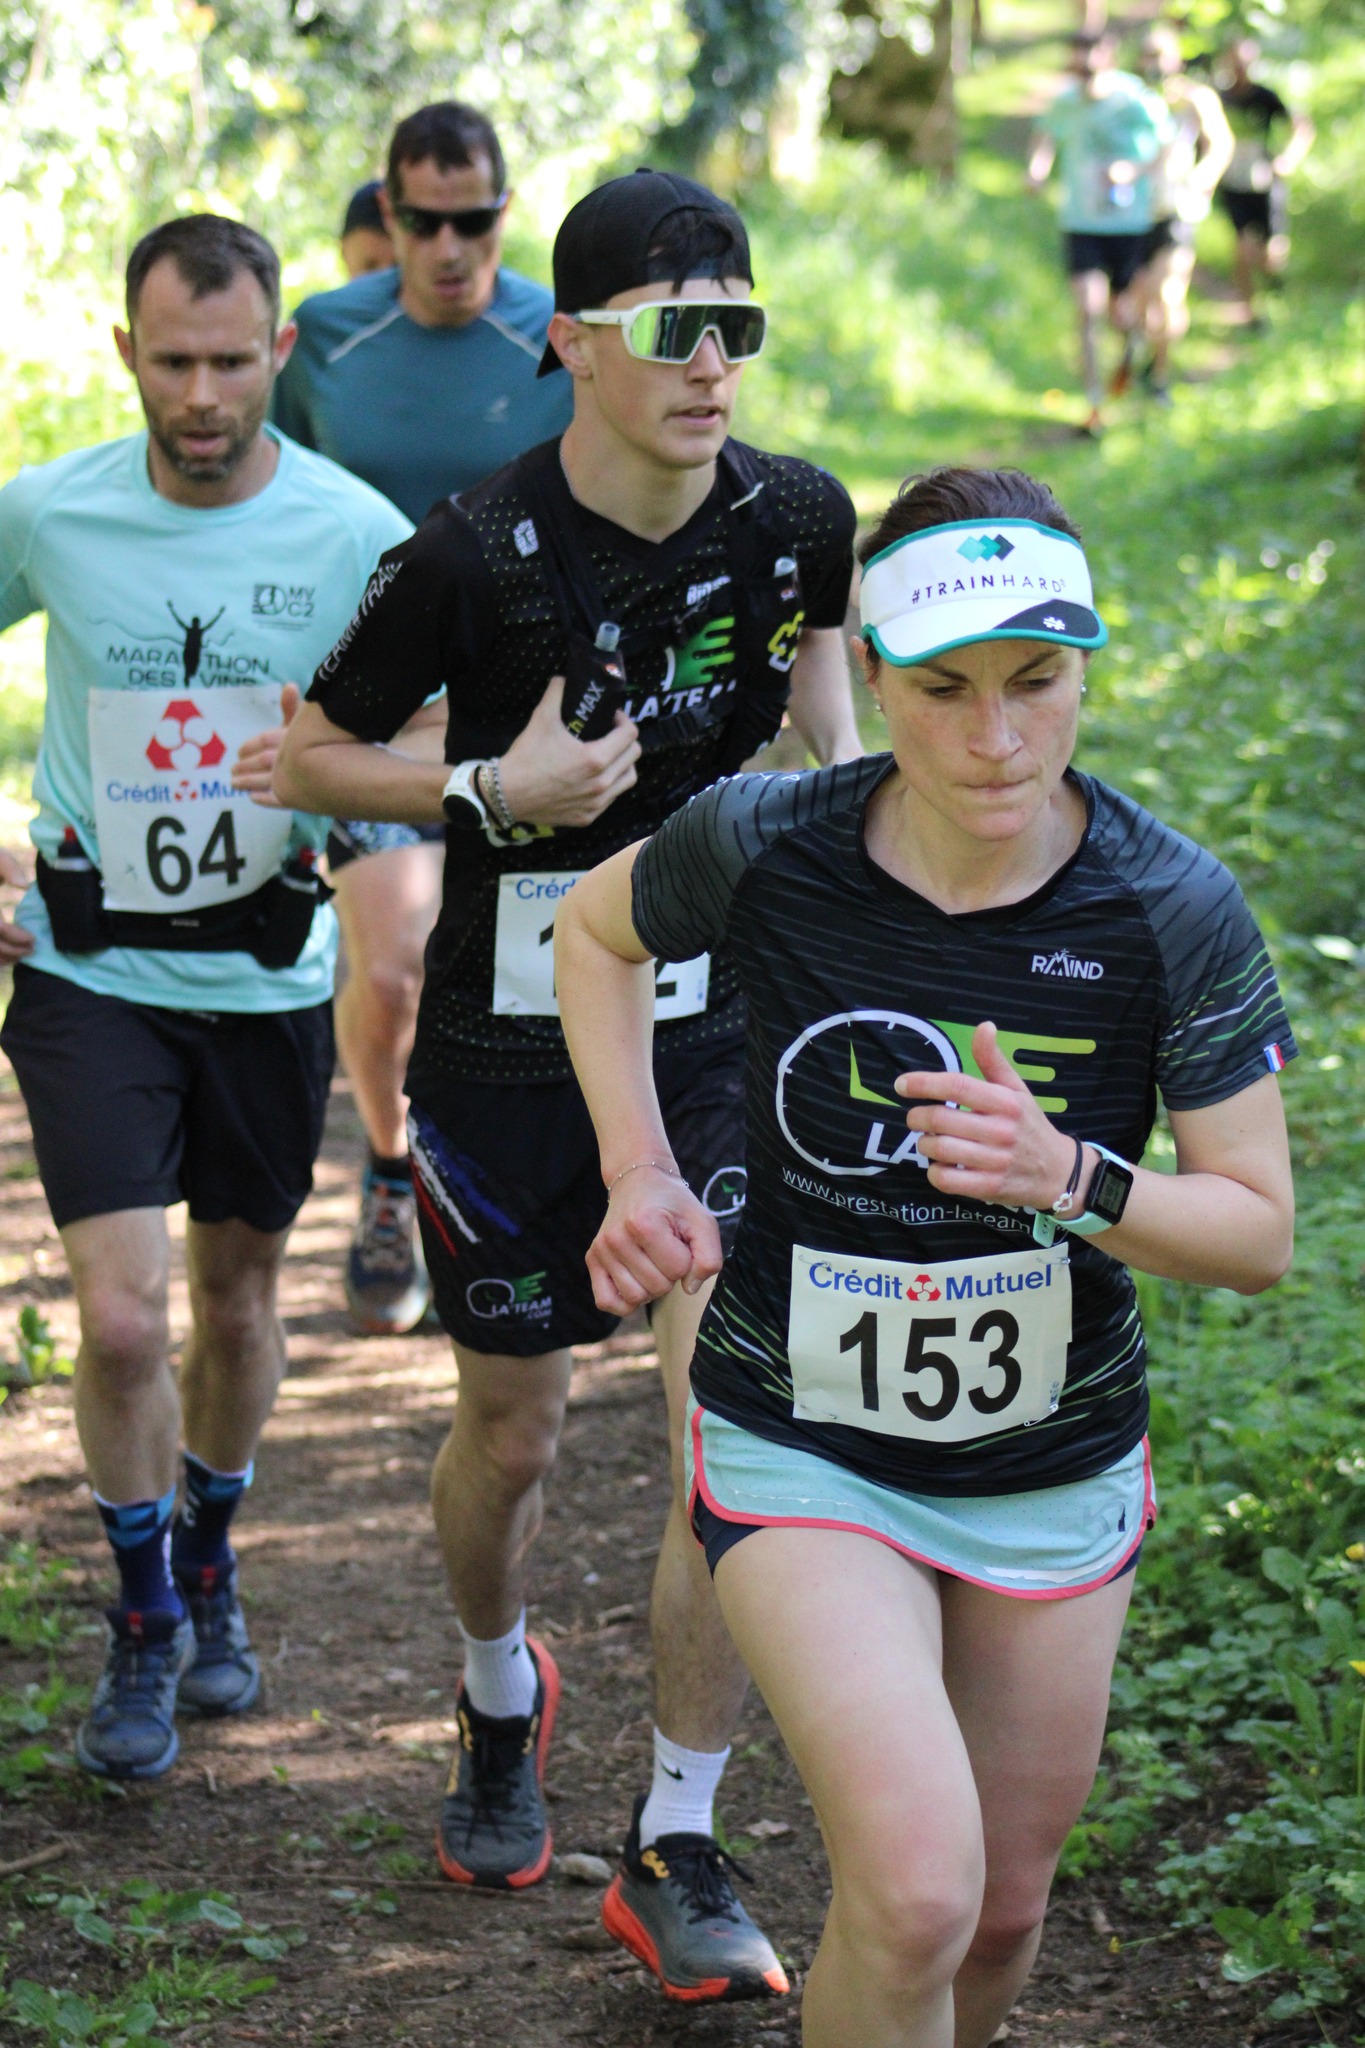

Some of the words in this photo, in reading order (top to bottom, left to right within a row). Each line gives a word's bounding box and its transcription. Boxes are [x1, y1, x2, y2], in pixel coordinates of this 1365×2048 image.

[288, 602, 314, 618] C2
[128, 669, 176, 687] DES
[575, 680, 605, 722] MAX
[107, 782, 171, 803] Crédit
[146, 810, 246, 896] 64
[808, 1262, 903, 1300] Crédit
[946, 1263, 1051, 1301] Mutuel
[839, 1309, 1022, 1422] 153
